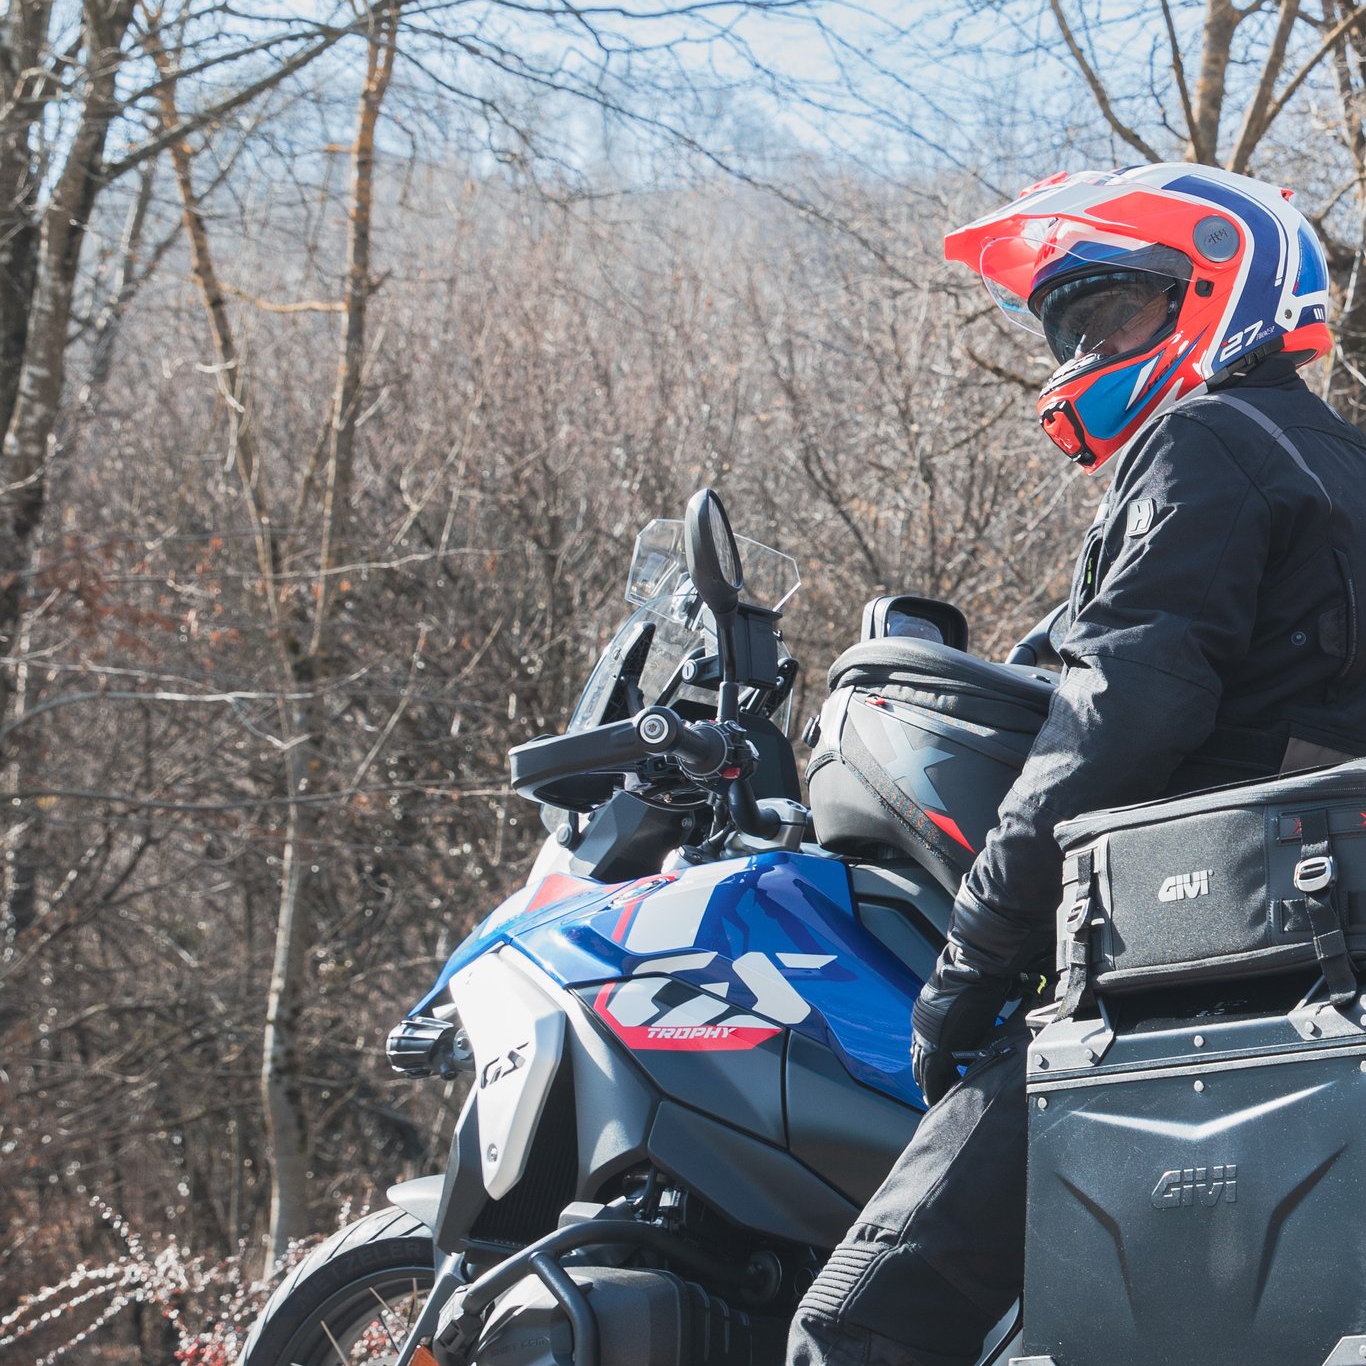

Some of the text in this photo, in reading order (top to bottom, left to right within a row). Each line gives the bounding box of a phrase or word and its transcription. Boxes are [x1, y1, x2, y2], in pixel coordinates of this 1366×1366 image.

[1158, 870, 1209, 902] GIVI
[606, 951, 838, 1028] GS
[647, 1027, 737, 1040] TROPHY
[481, 1041, 529, 1089] GS
[1151, 1164, 1237, 1210] GIVI
